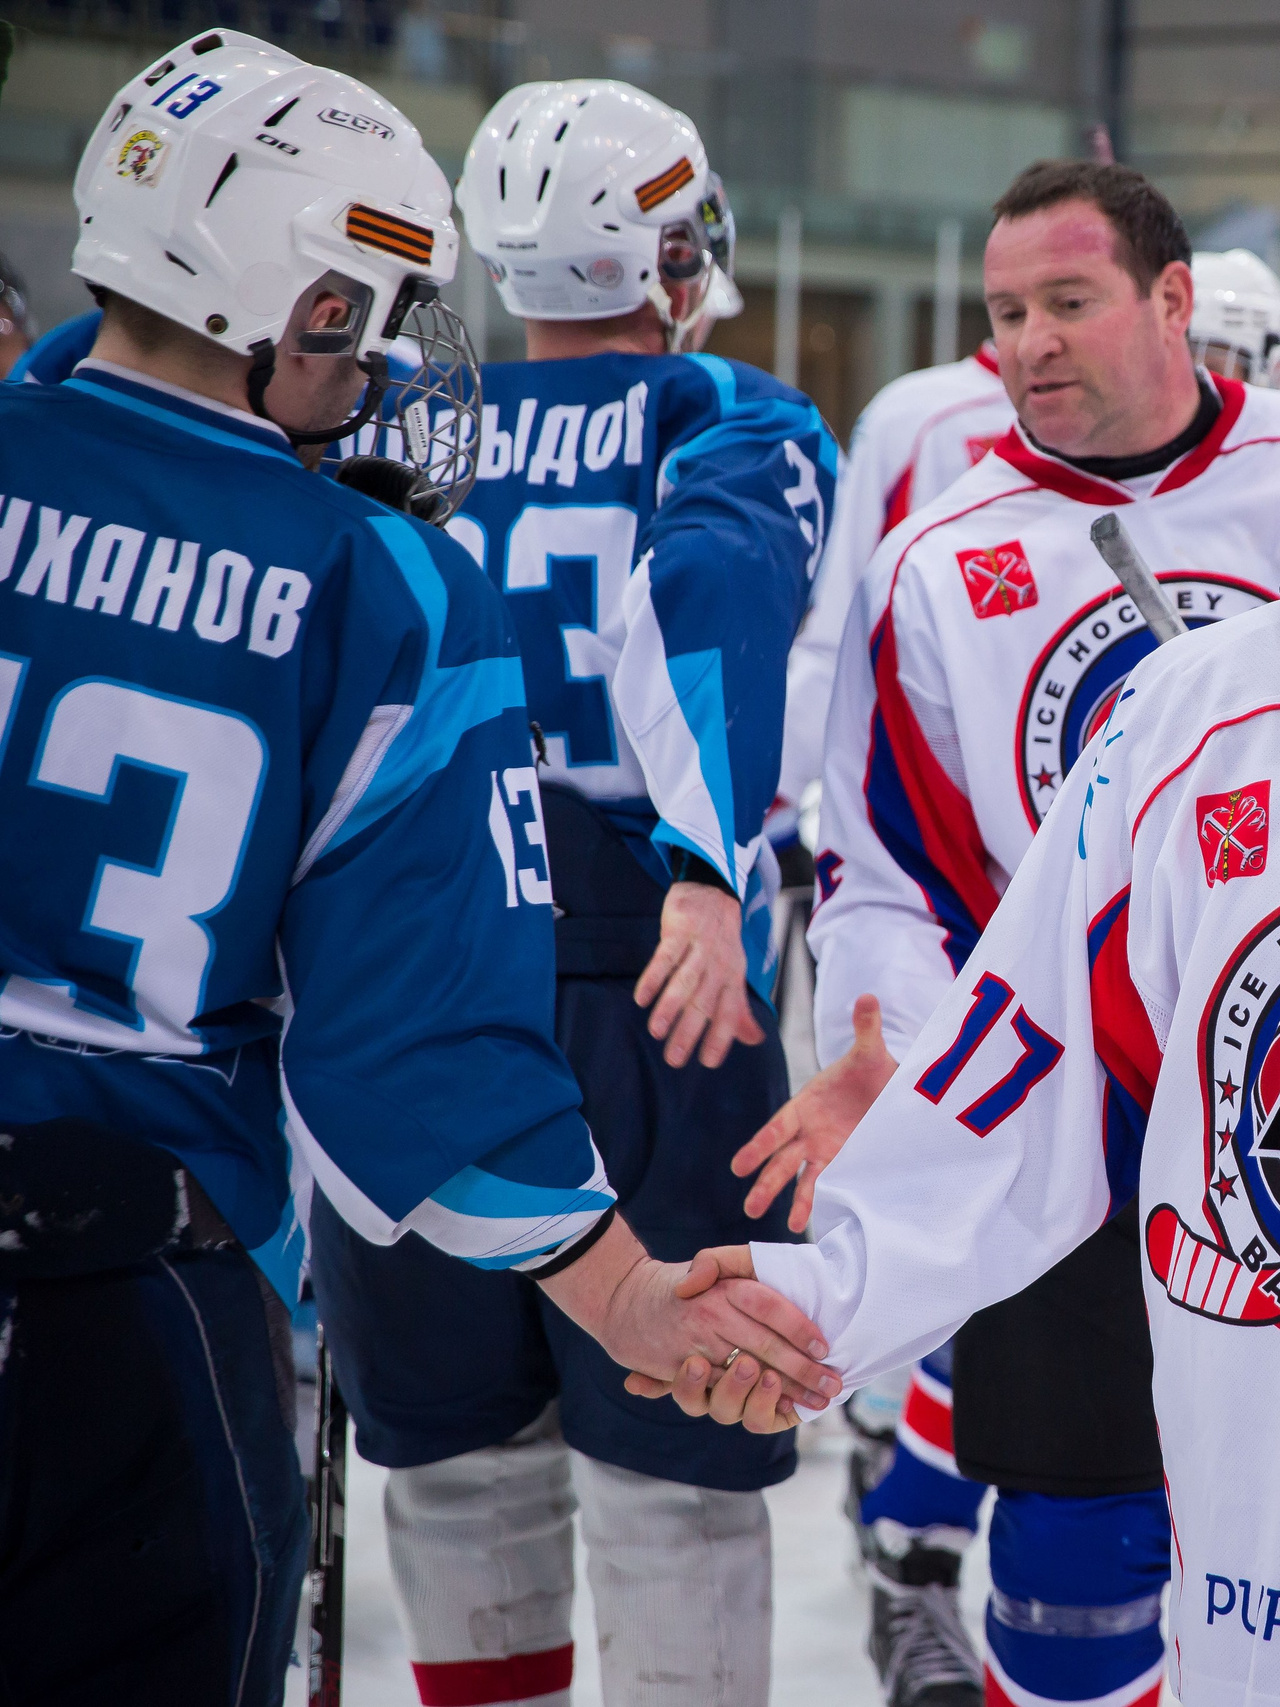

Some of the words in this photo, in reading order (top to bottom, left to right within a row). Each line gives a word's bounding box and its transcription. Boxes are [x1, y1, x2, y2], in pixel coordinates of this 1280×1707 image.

[150, 72, 223, 120] 13
[443, 503, 660, 801] 3
[1034, 680, 1065, 744] ICE
[1067, 591, 1223, 663] HOCEY
[488, 766, 553, 908] 13
[913, 970, 1066, 1139] 17
[1223, 971, 1267, 1050] ICE
